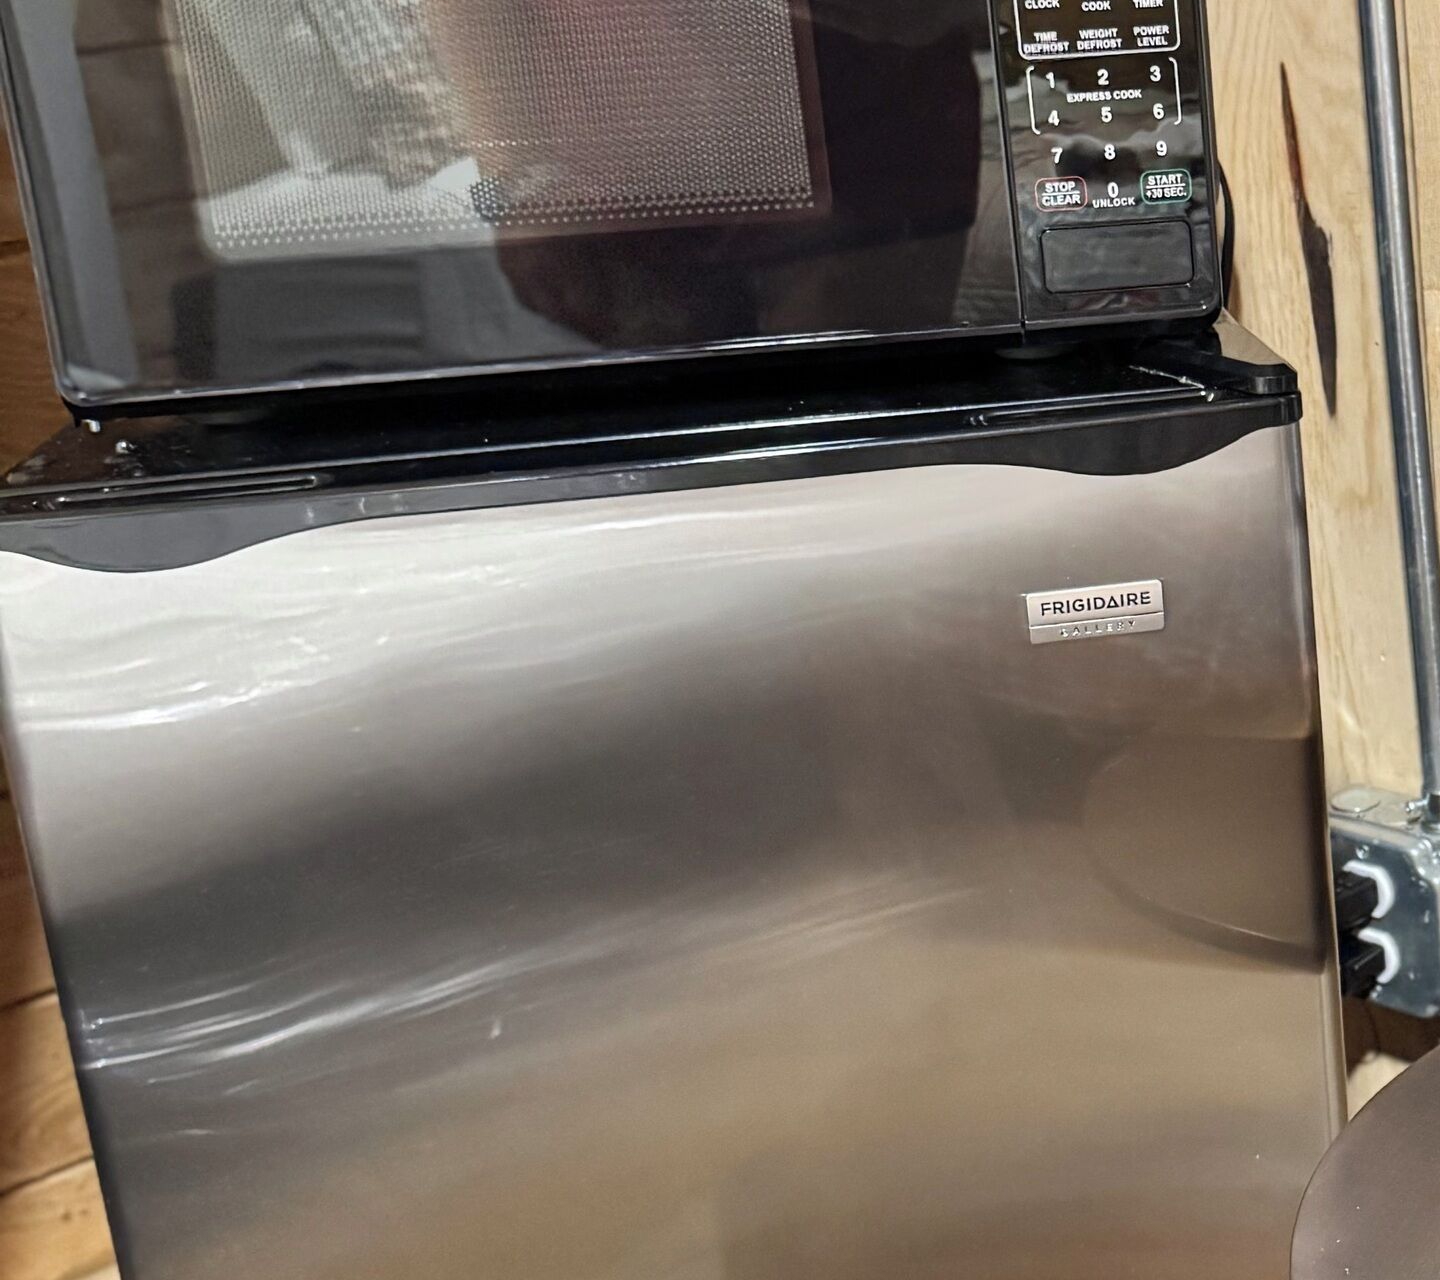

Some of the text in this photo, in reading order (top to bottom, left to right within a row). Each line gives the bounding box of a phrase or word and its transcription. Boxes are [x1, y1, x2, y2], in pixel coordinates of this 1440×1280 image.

[1081, 0, 1112, 12] COOK
[1033, 31, 1058, 42] TIME
[1079, 27, 1118, 40] WEIGHT
[1133, 25, 1169, 37] POWER
[1023, 41, 1069, 54] DEFROST
[1076, 38, 1123, 51] DEFROST
[1137, 35, 1168, 47] LEVEL
[1046, 71, 1056, 89] 1
[1097, 69, 1109, 86] 2
[1150, 65, 1161, 82] 3
[1066, 89, 1142, 103] EXPRESS COOK
[1047, 110, 1060, 126] 4
[1101, 106, 1112, 123] 5
[1152, 103, 1165, 120] 6
[1051, 147, 1063, 164] 7
[1104, 144, 1116, 160] 8
[1156, 140, 1167, 157] 9
[1147, 173, 1183, 186] START
[1045, 181, 1076, 193] STOP
[1108, 182, 1119, 198] 0
[1164, 186, 1187, 198] SEC.
[1041, 194, 1081, 207] CLEAR
[1092, 196, 1136, 209] UNLOCK
[1041, 591, 1151, 616] FRIGIDAIRE
[1060, 620, 1136, 638] GALLERY
